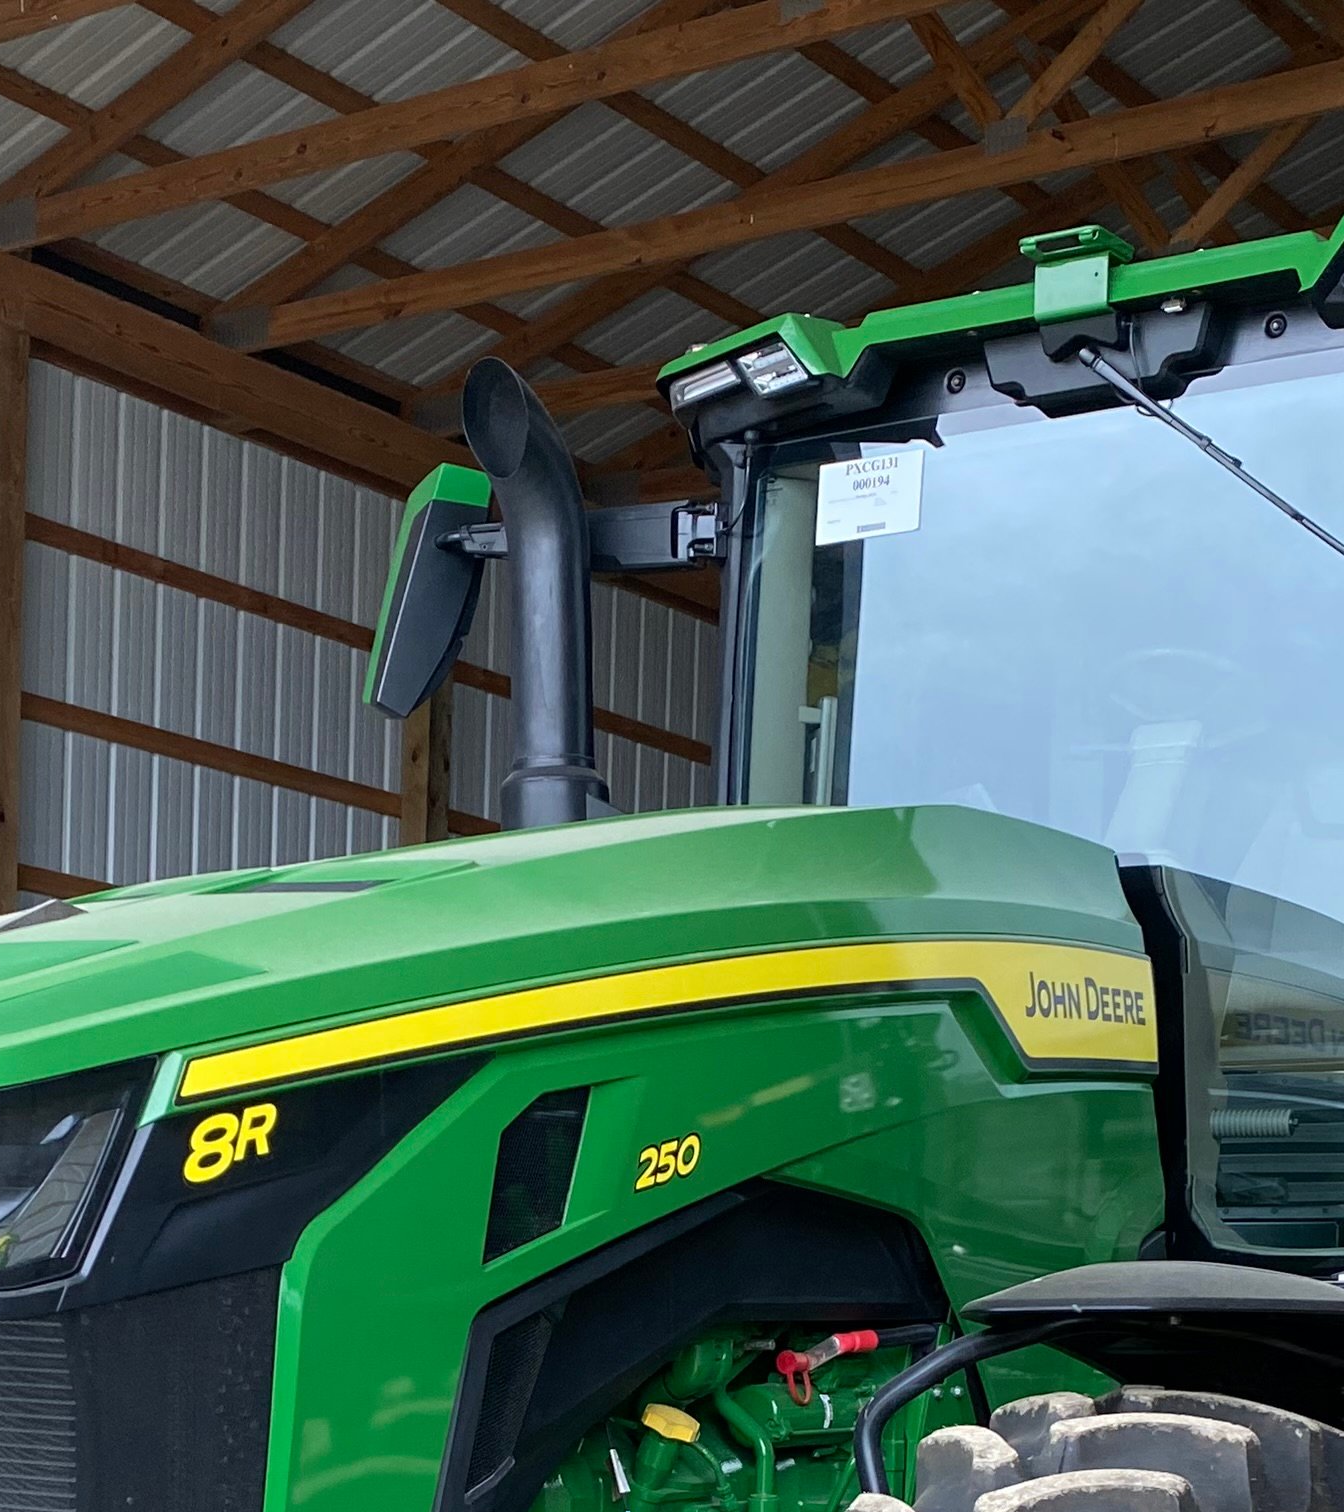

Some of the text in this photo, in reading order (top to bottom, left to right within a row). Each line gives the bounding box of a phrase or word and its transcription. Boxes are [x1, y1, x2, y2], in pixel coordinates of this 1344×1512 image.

[846, 456, 899, 476] PXCG131
[852, 474, 890, 491] 000194
[1025, 971, 1146, 1026] JOHN DEERE
[183, 1103, 277, 1183] 8R
[635, 1133, 701, 1191] 250
